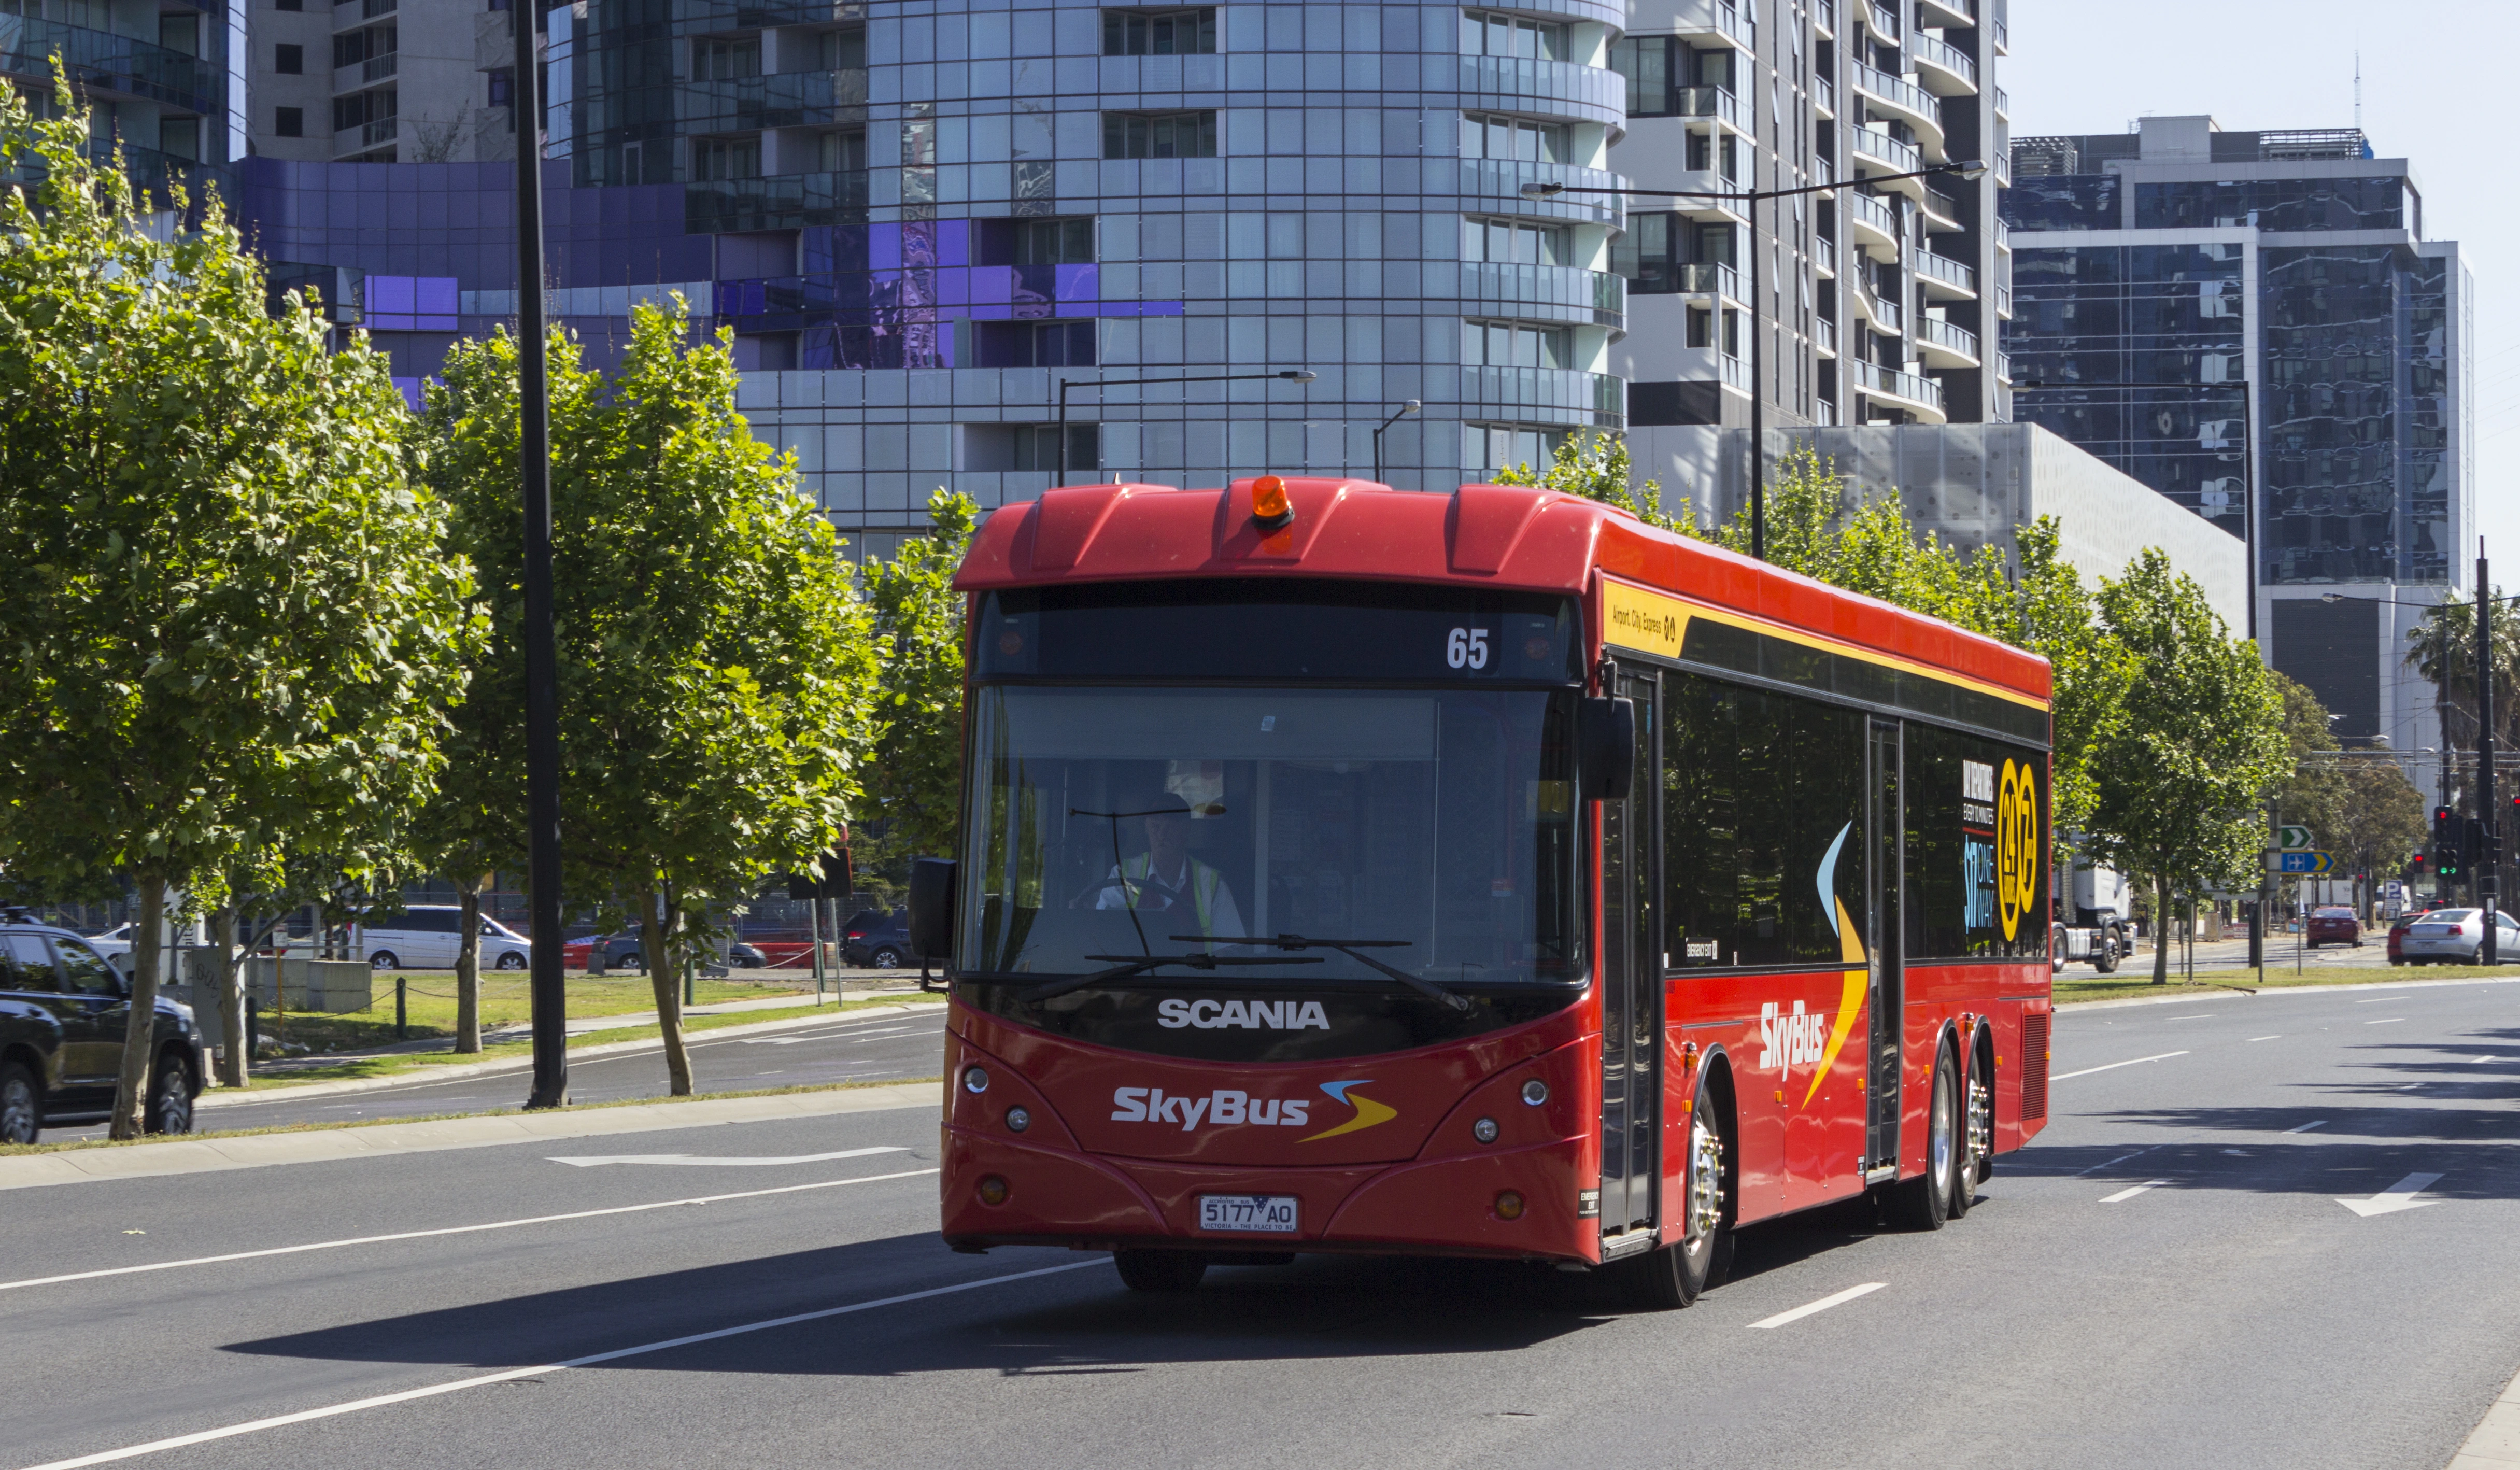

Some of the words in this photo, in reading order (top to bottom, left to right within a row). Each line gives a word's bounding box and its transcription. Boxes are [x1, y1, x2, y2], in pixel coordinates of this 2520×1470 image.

[1612, 604, 1631, 629] Airport.
[1632, 609, 1641, 633] City.
[1643, 613, 1661, 636] Express
[1447, 628, 1488, 669] 65
[1963, 803, 1974, 822] EVERY
[1979, 807, 1994, 825] MINUTES
[2004, 793, 2015, 873] 24
[2022, 800, 2030, 883] 7
[1978, 843, 1994, 883] ONE
[1964, 835, 1977, 935] $17
[2386, 882, 2399, 898] P
[1977, 888, 1994, 928] WAY
[1687, 944, 1705, 957] EMERGENCY
[1157, 999, 1330, 1030] SCANIA
[1760, 1000, 1824, 1082] SkyBus
[1111, 1087, 1310, 1132] SkyBus
[1206, 1204, 1254, 1222] 5177
[1267, 1205, 1291, 1223] AO
